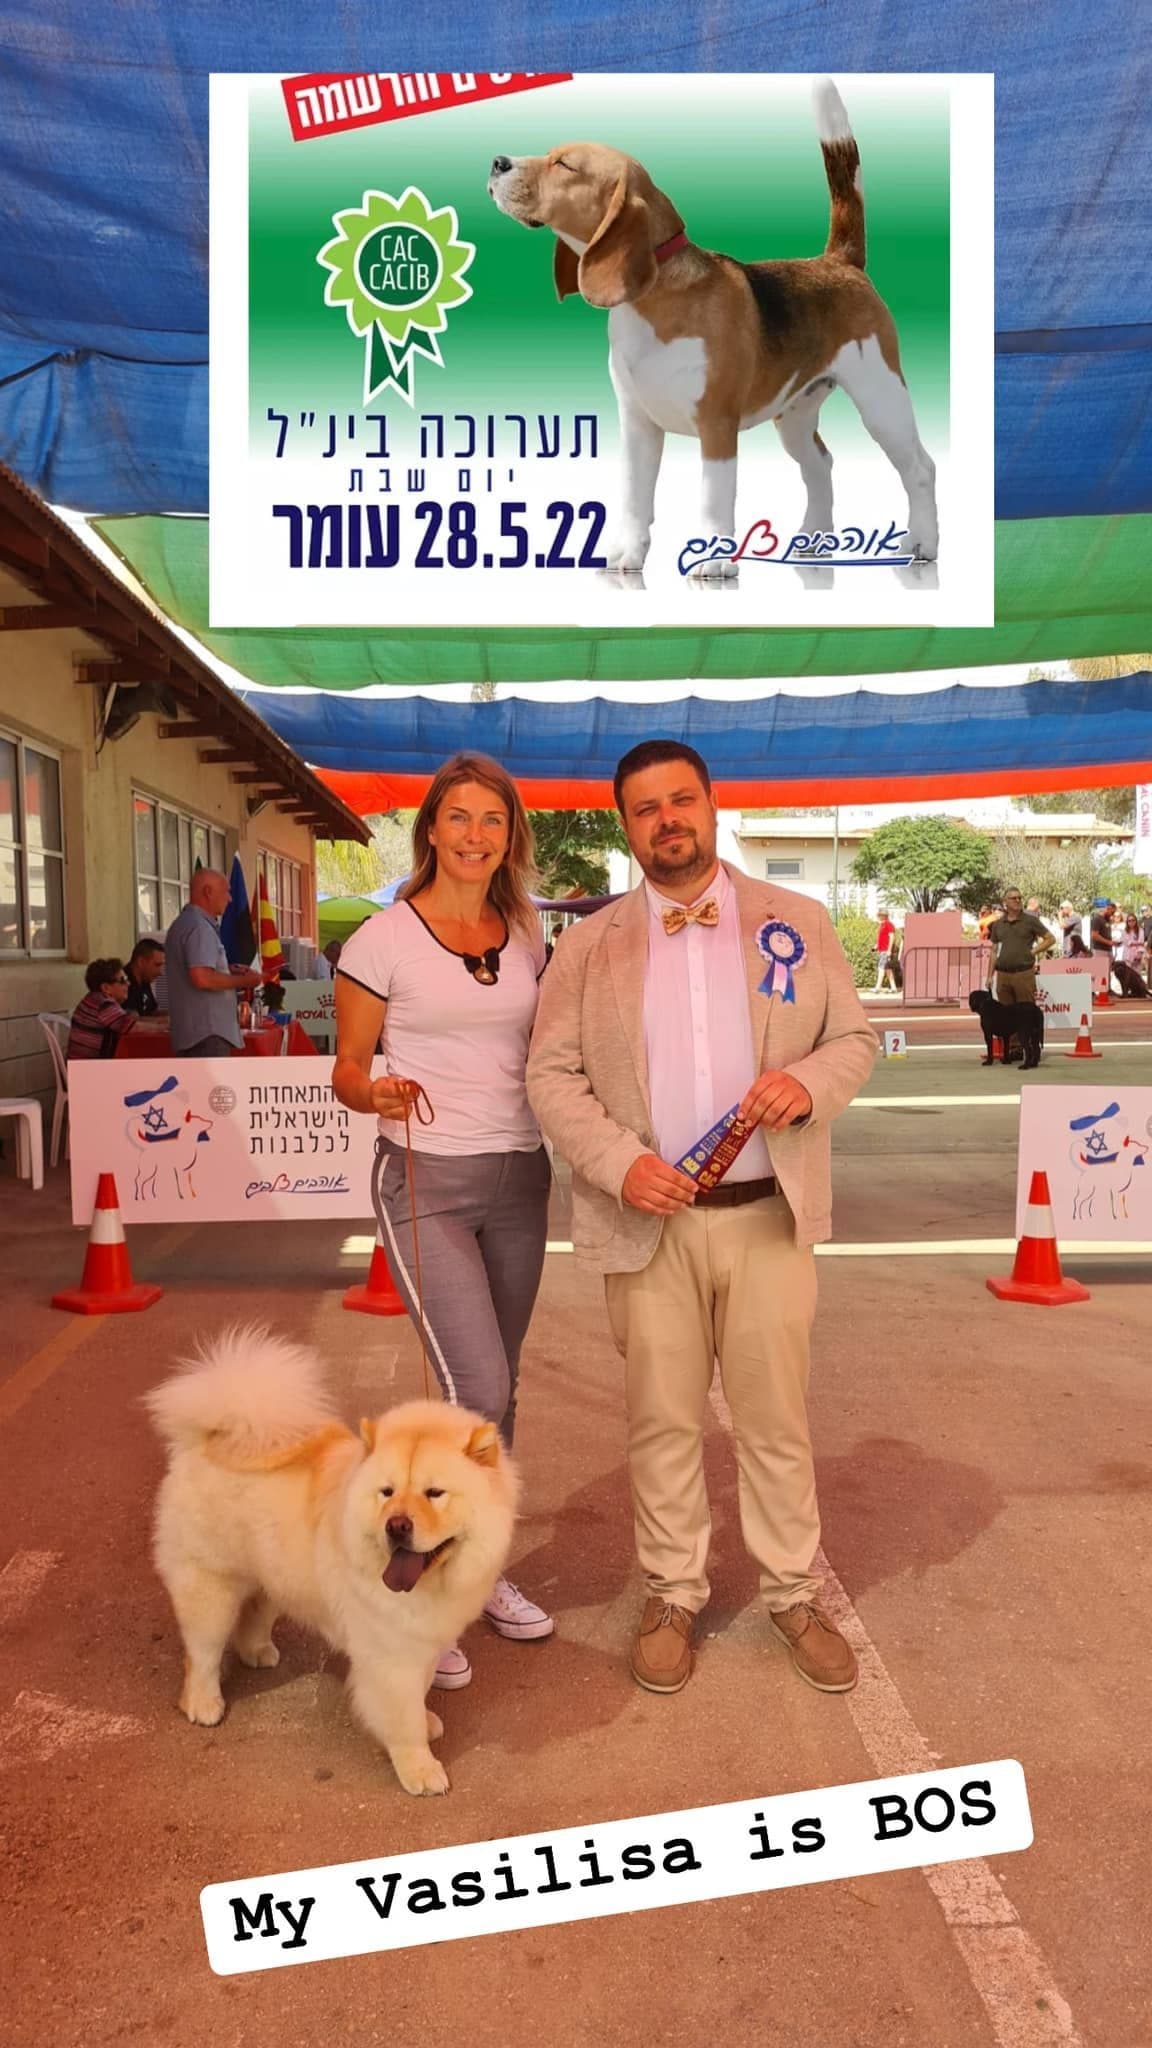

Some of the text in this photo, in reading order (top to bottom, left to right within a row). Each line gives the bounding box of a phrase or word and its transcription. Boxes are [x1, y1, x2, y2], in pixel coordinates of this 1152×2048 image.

[296, 1010, 329, 1020] ROYAL
[892, 1038, 900, 1052] 2
[249, 1086, 336, 1104] התאחדות
[249, 1107, 348, 1129] הישראלית
[249, 1130, 349, 1154] לכלבנות
